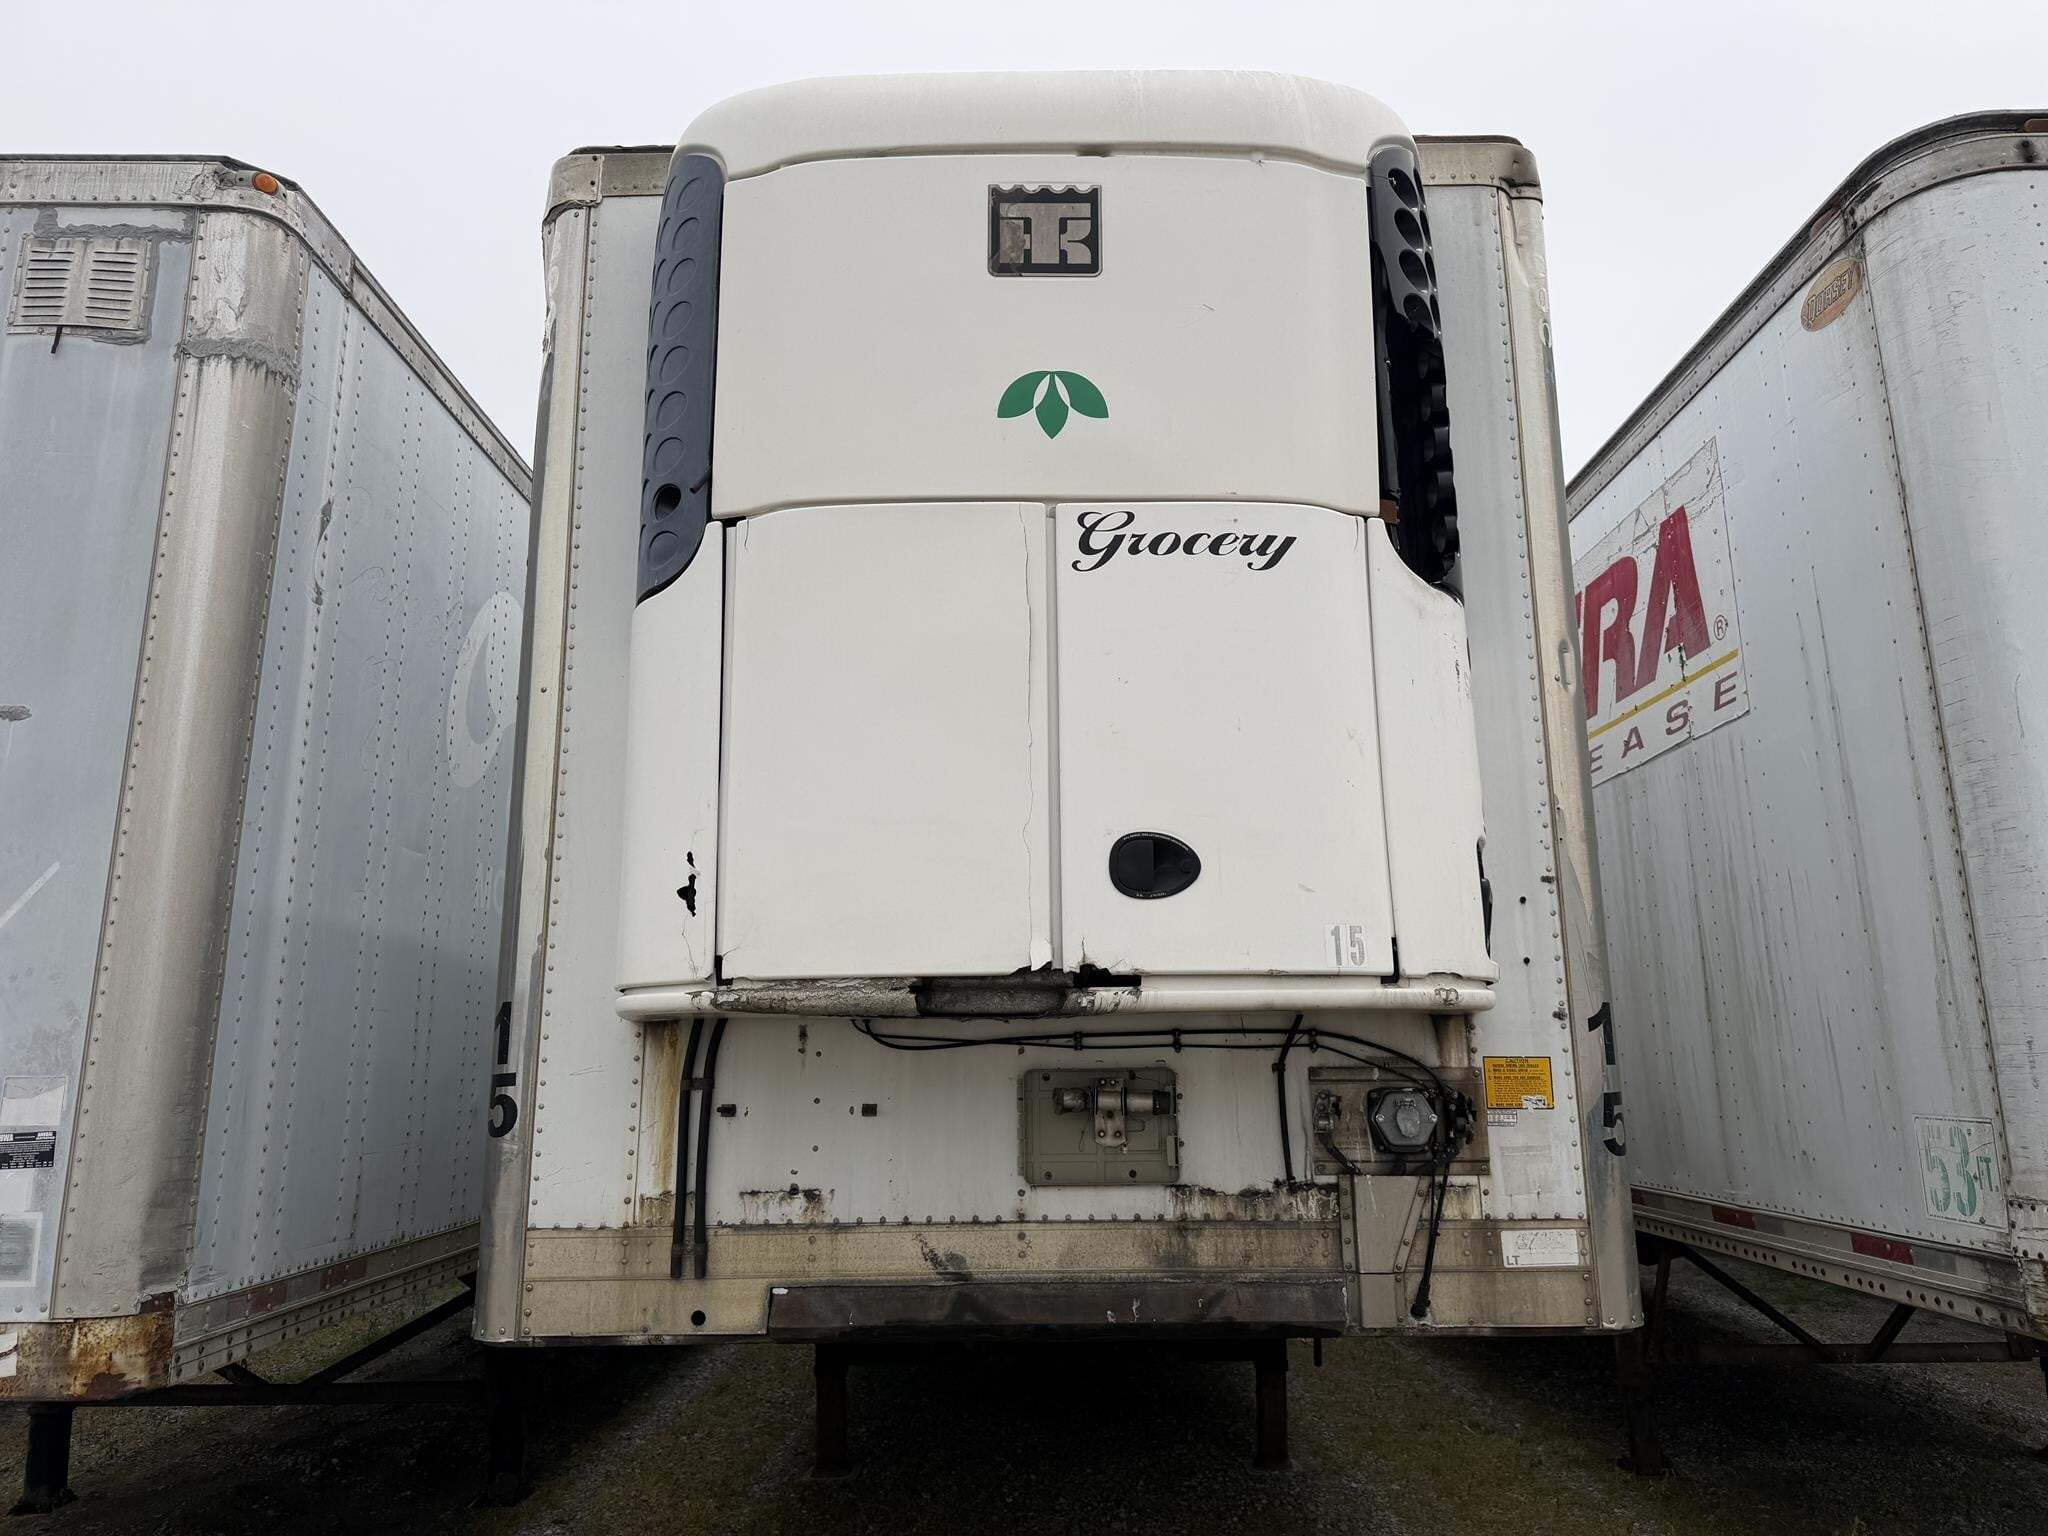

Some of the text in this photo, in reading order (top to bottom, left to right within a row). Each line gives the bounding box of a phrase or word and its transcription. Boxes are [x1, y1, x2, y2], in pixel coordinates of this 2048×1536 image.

[1071, 510, 1298, 572] Grocery
[1330, 925, 1365, 966] 15
[1923, 1125, 1977, 1217] 53
[1506, 1255, 1520, 1265] LT
